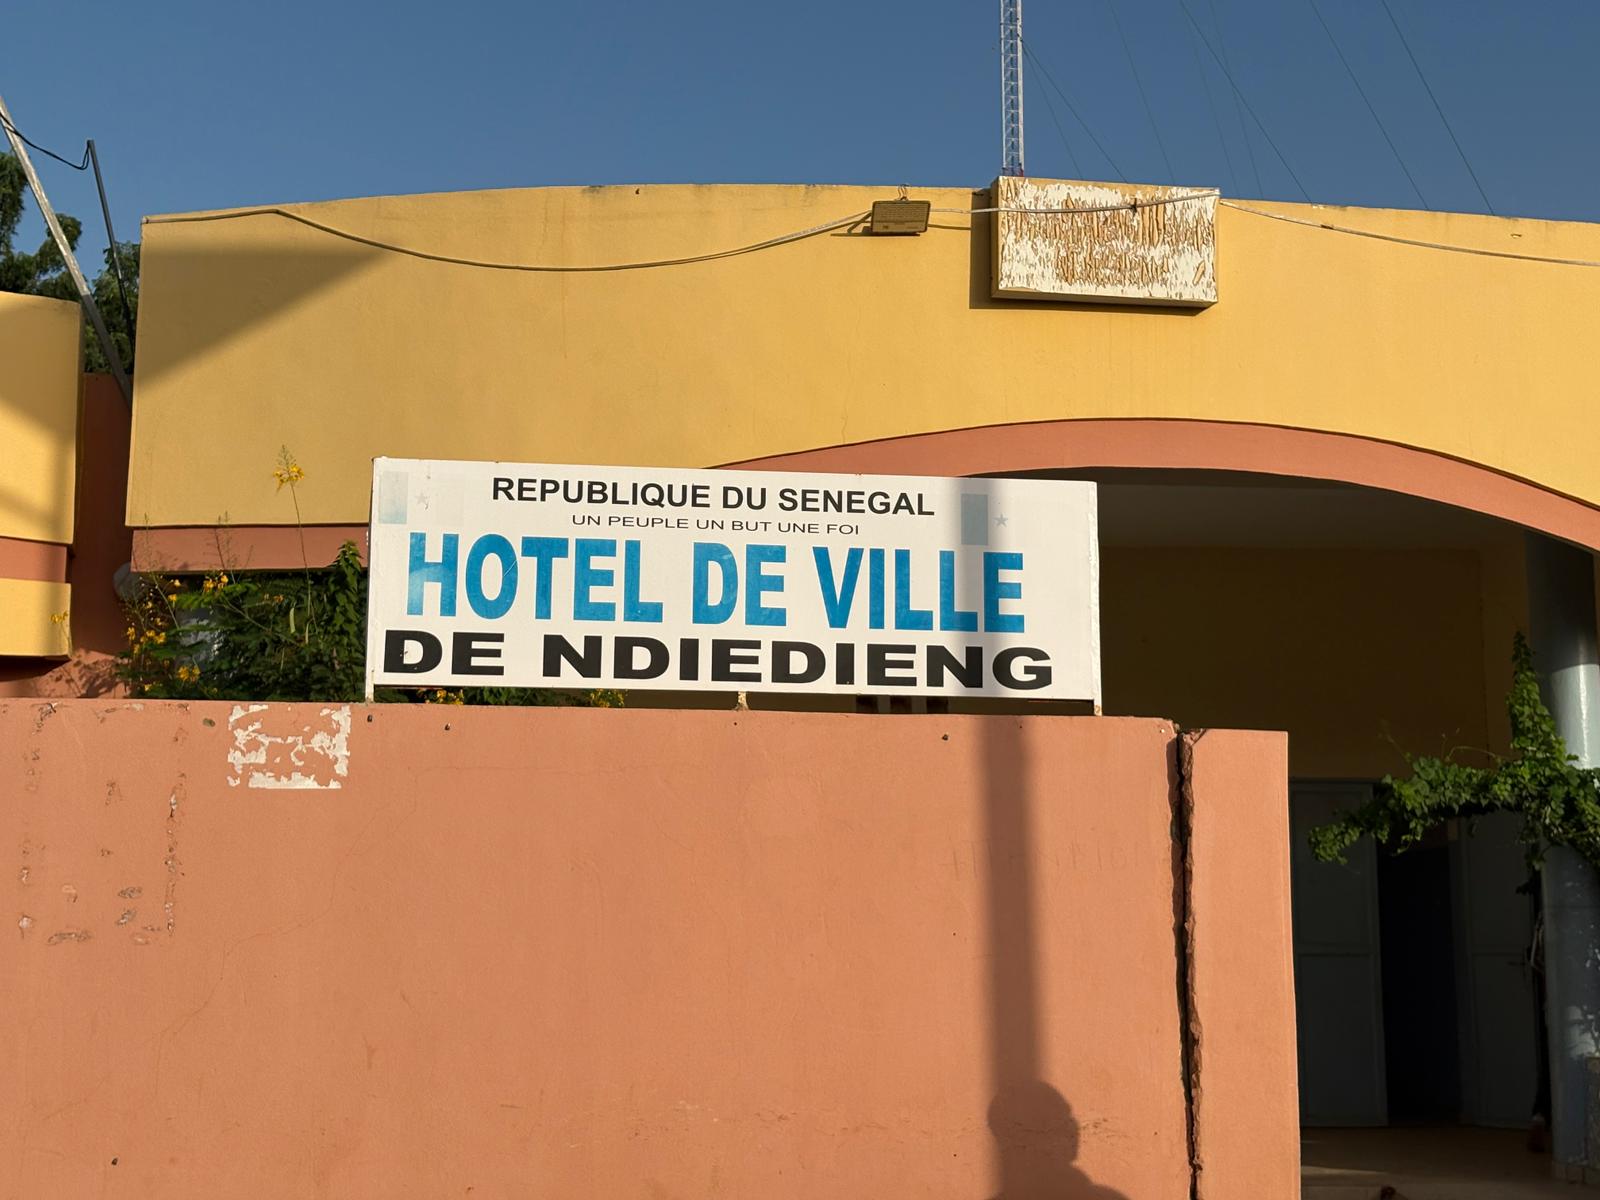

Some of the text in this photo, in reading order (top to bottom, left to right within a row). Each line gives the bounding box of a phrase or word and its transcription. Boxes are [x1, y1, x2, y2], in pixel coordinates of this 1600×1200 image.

[492, 477, 935, 516] REPUBLIQUE DU SENEGAL
[572, 514, 859, 535] UN PEUPLE UN BUT UNE FOI
[407, 532, 1025, 633] HOTEL DE VILLE
[383, 629, 1053, 690] DE NDIEDIENG
